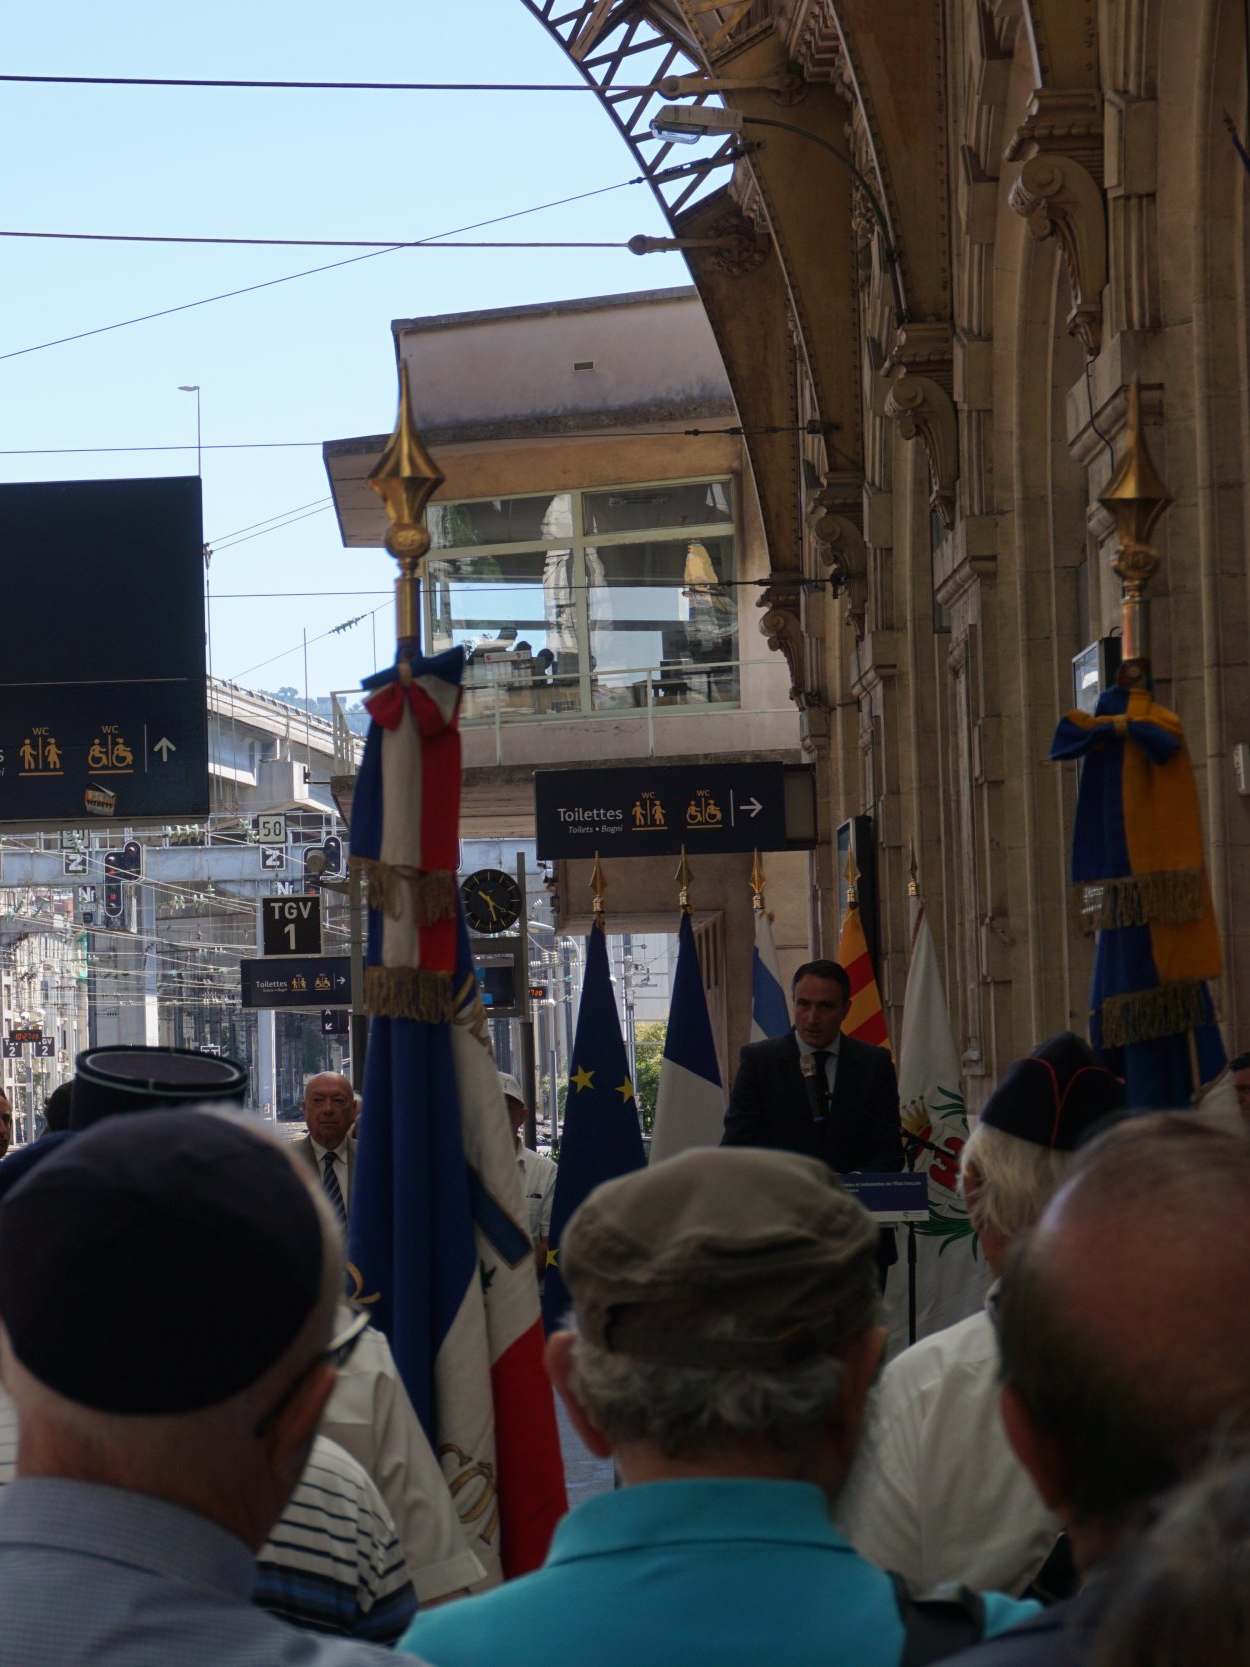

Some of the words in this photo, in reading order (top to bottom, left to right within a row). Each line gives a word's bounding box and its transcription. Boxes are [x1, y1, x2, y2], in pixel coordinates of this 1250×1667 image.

[32, 727, 49, 736] WC
[102, 725, 118, 734] WC
[641, 791, 655, 799] WC
[697, 790, 711, 798] WC
[557, 807, 623, 822] Toilettes
[263, 821, 282, 837] 50
[568, 826, 594, 834] Toilets
[601, 824, 623, 834] Bagni
[69, 855, 83, 870] Z
[265, 850, 280, 866] Z
[78, 886, 95, 903] Nr
[270, 902, 312, 919] TGV
[284, 923, 296, 950] 1
[255, 980, 288, 989] Toilettes
[9, 1046, 16, 1056] 2
[41, 1045, 49, 1056] 2
